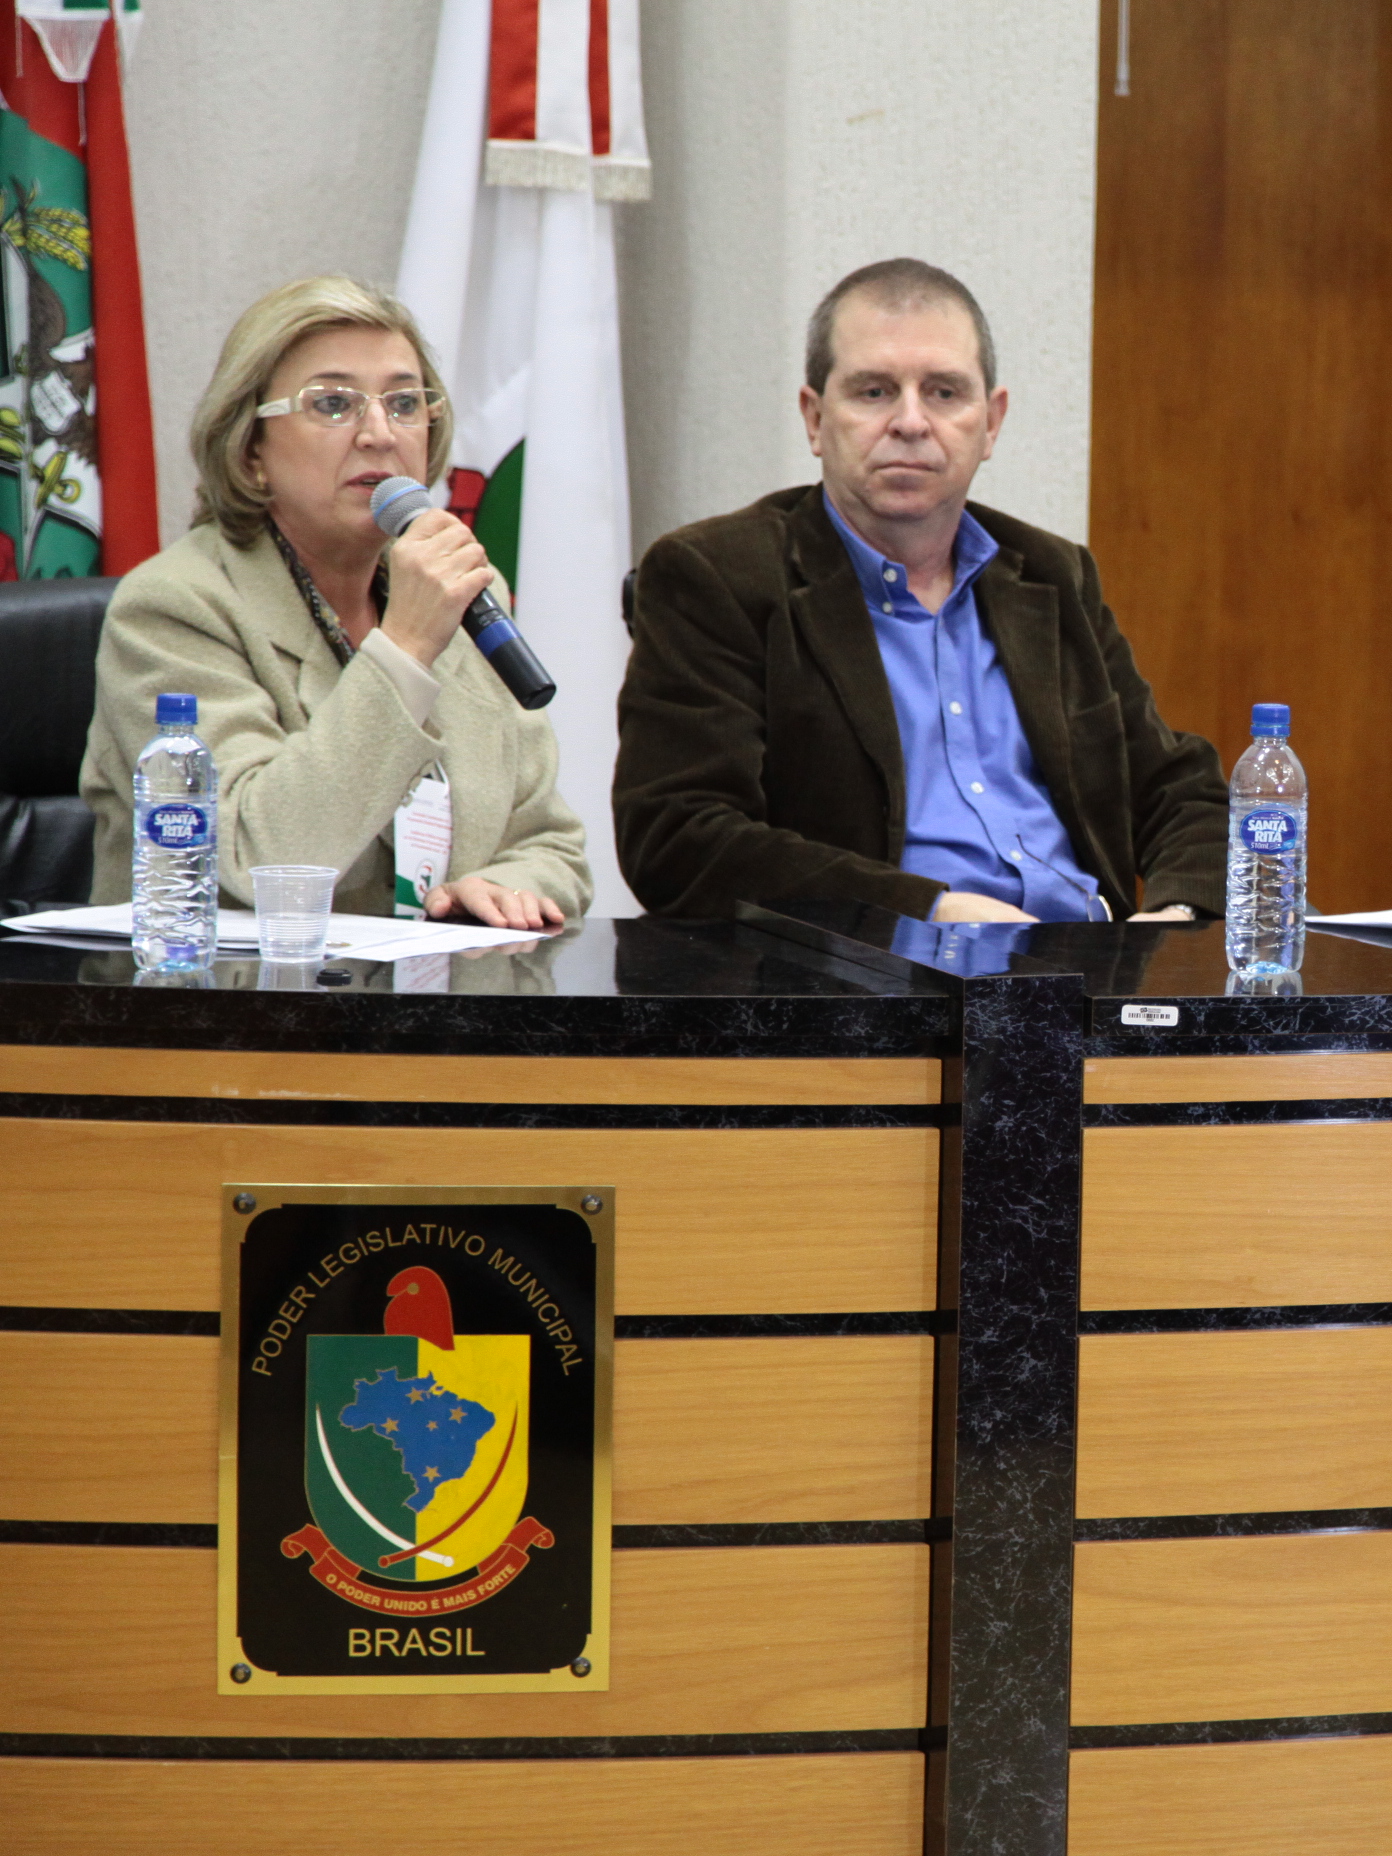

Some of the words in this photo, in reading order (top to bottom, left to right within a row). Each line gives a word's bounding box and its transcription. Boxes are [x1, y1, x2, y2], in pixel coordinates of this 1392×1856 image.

[154, 813, 199, 826] SANTA
[1247, 819, 1288, 832] SANTA
[162, 825, 193, 837] RITA
[1254, 830, 1283, 843] RITA
[251, 1285, 316, 1376] PODER
[307, 1223, 486, 1289] LEGISLATIVO
[487, 1247, 583, 1376] MUNICIPAL
[325, 1573, 338, 1585] O
[337, 1580, 381, 1608] PODER
[383, 1598, 428, 1612] UNIDO
[431, 1596, 441, 1609] É
[443, 1590, 478, 1608] MAIS
[477, 1564, 517, 1596] FORTE
[348, 1627, 487, 1657] BRASIL
